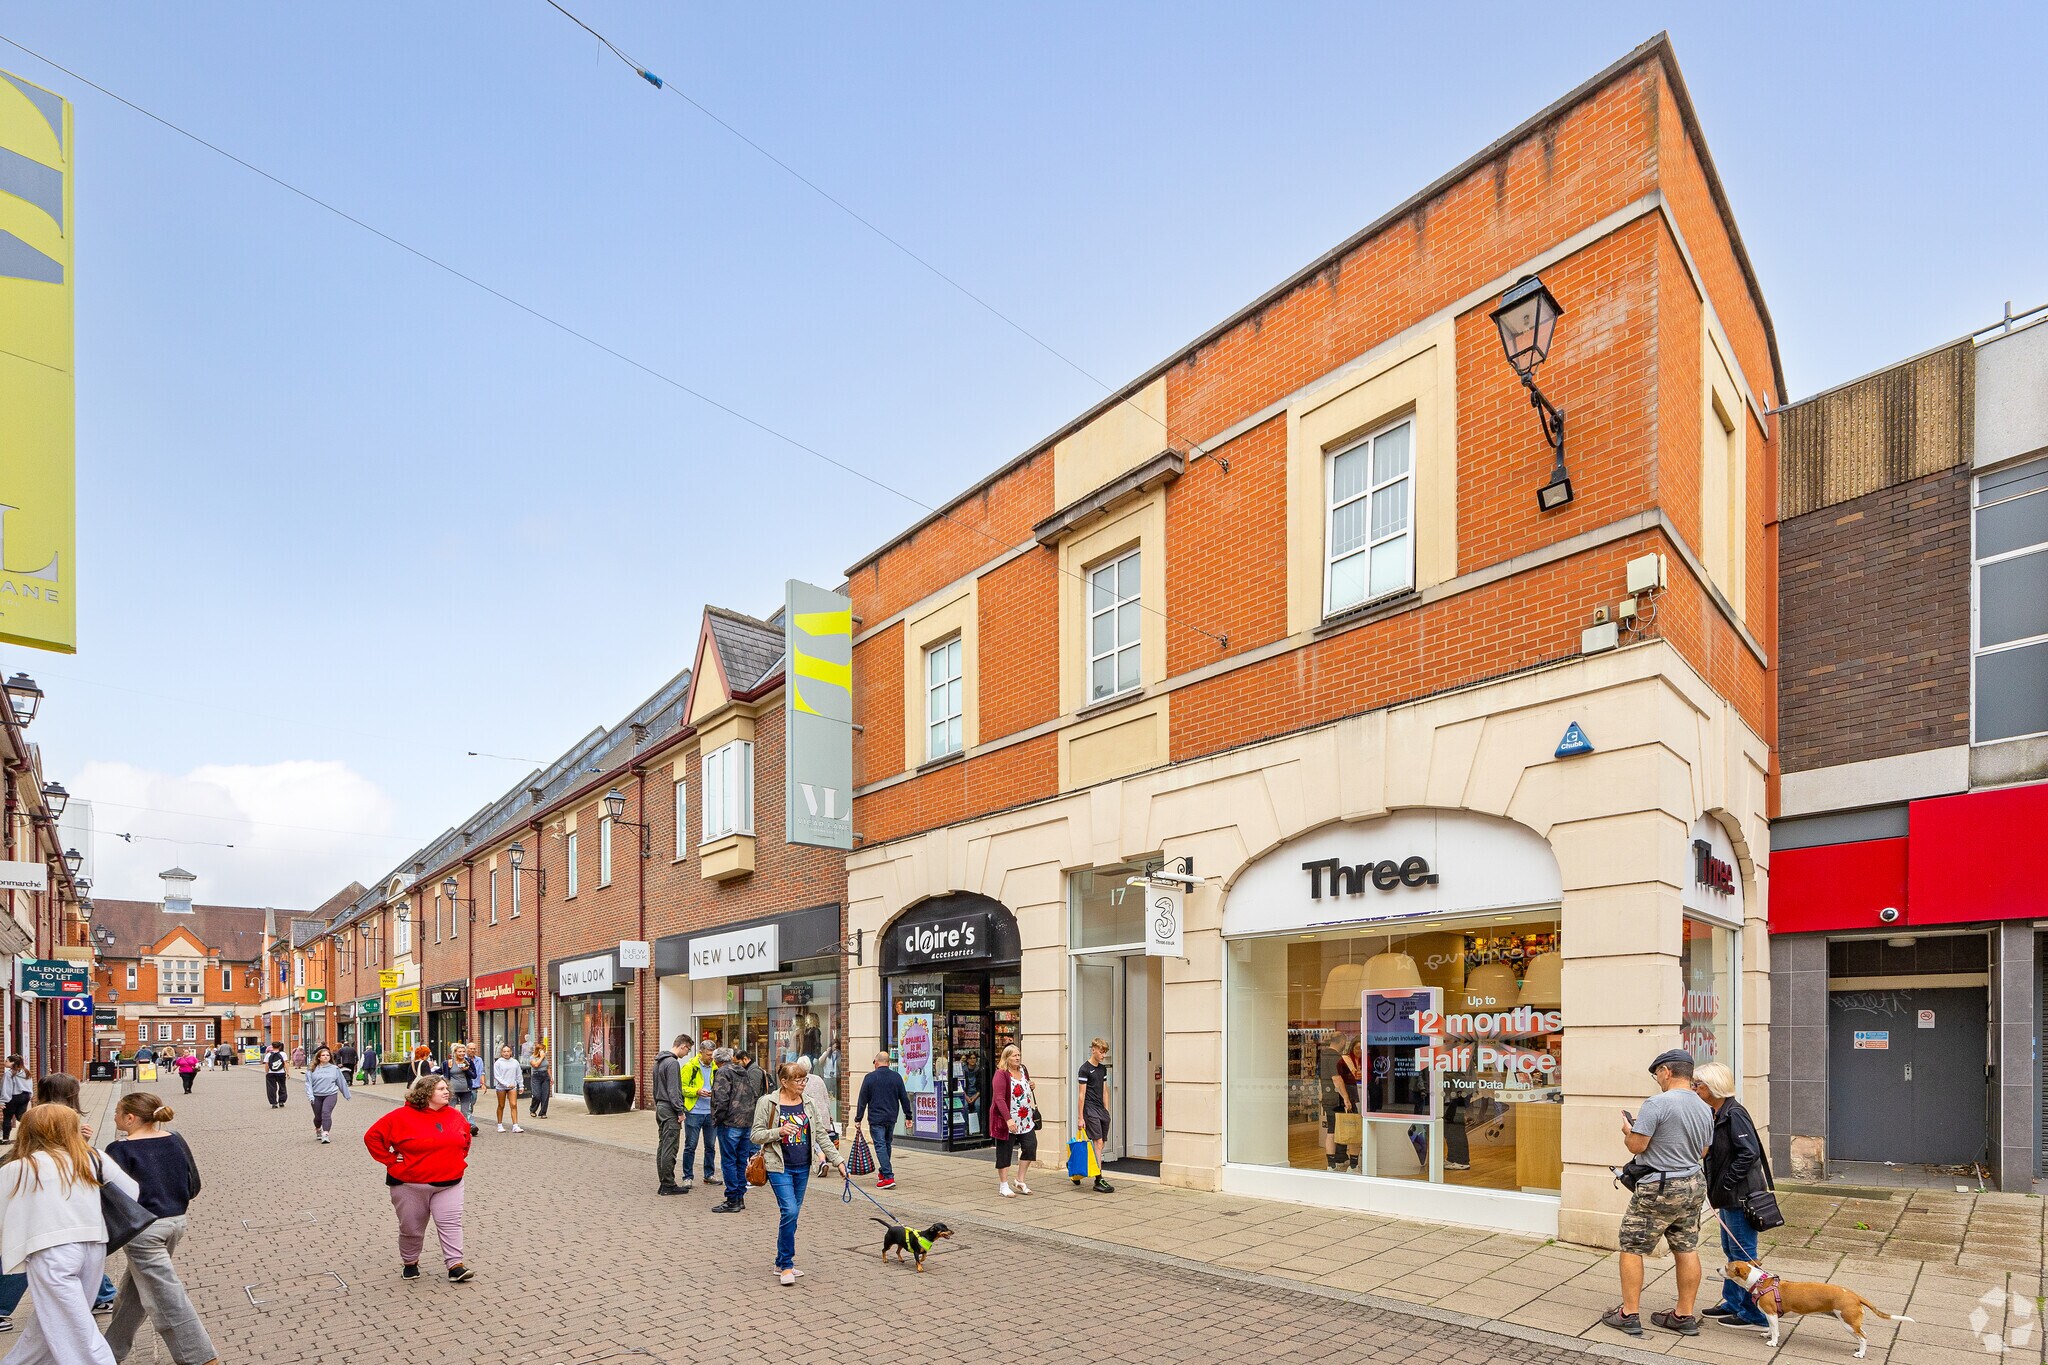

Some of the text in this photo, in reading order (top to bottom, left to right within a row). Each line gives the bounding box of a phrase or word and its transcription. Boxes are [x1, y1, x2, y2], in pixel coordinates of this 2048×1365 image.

[1561, 740, 1583, 750] Chubb
[797, 782, 850, 821] VL
[1110, 887, 1126, 906] 17
[905, 922, 975, 954] claire's
[693, 941, 767, 966] NEW LOOK
[931, 947, 974, 959] accessories
[43, 966, 85, 974] ENQUIRIES
[561, 968, 605, 986] NEW LOOK
[311, 991, 322, 1001] D
[444, 991, 459, 1001] W
[913, 986, 928, 997] ear
[904, 998, 936, 1012] piercing
[1467, 995, 1496, 1007] Up to
[1408, 1005, 1563, 1034] 12 months
[905, 1035, 926, 1045] SPARKLE
[1414, 1047, 1557, 1074] Half Price
[1452, 1079, 1477, 1088] Your
[1478, 1079, 1504, 1089] Data
[917, 1096, 936, 1108] FREE
